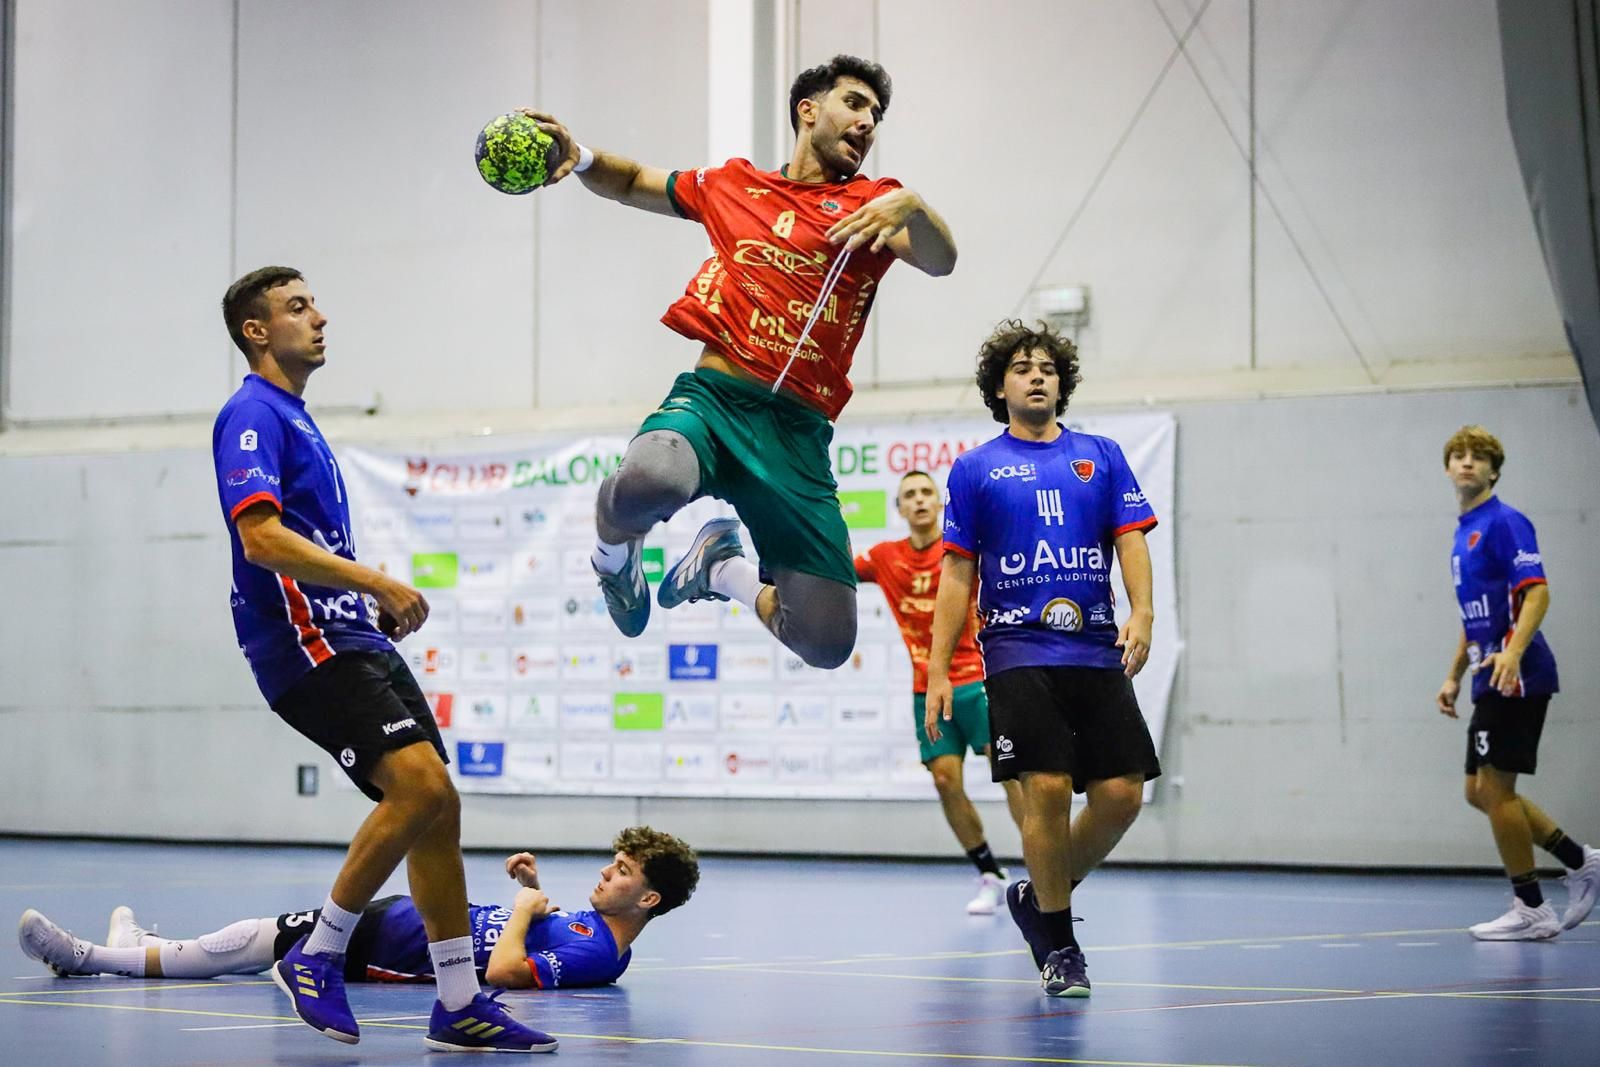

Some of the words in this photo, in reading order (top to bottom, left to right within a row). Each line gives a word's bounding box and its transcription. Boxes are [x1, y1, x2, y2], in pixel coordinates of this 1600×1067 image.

[771, 210, 796, 239] 8
[431, 462, 508, 492] CLUB
[837, 444, 879, 475] DE
[1035, 489, 1064, 526] 44
[1032, 539, 1108, 572] Aural
[996, 574, 1050, 590] CENTROS
[1056, 572, 1109, 584] AUDITIVOS
[438, 957, 472, 968] adidas
